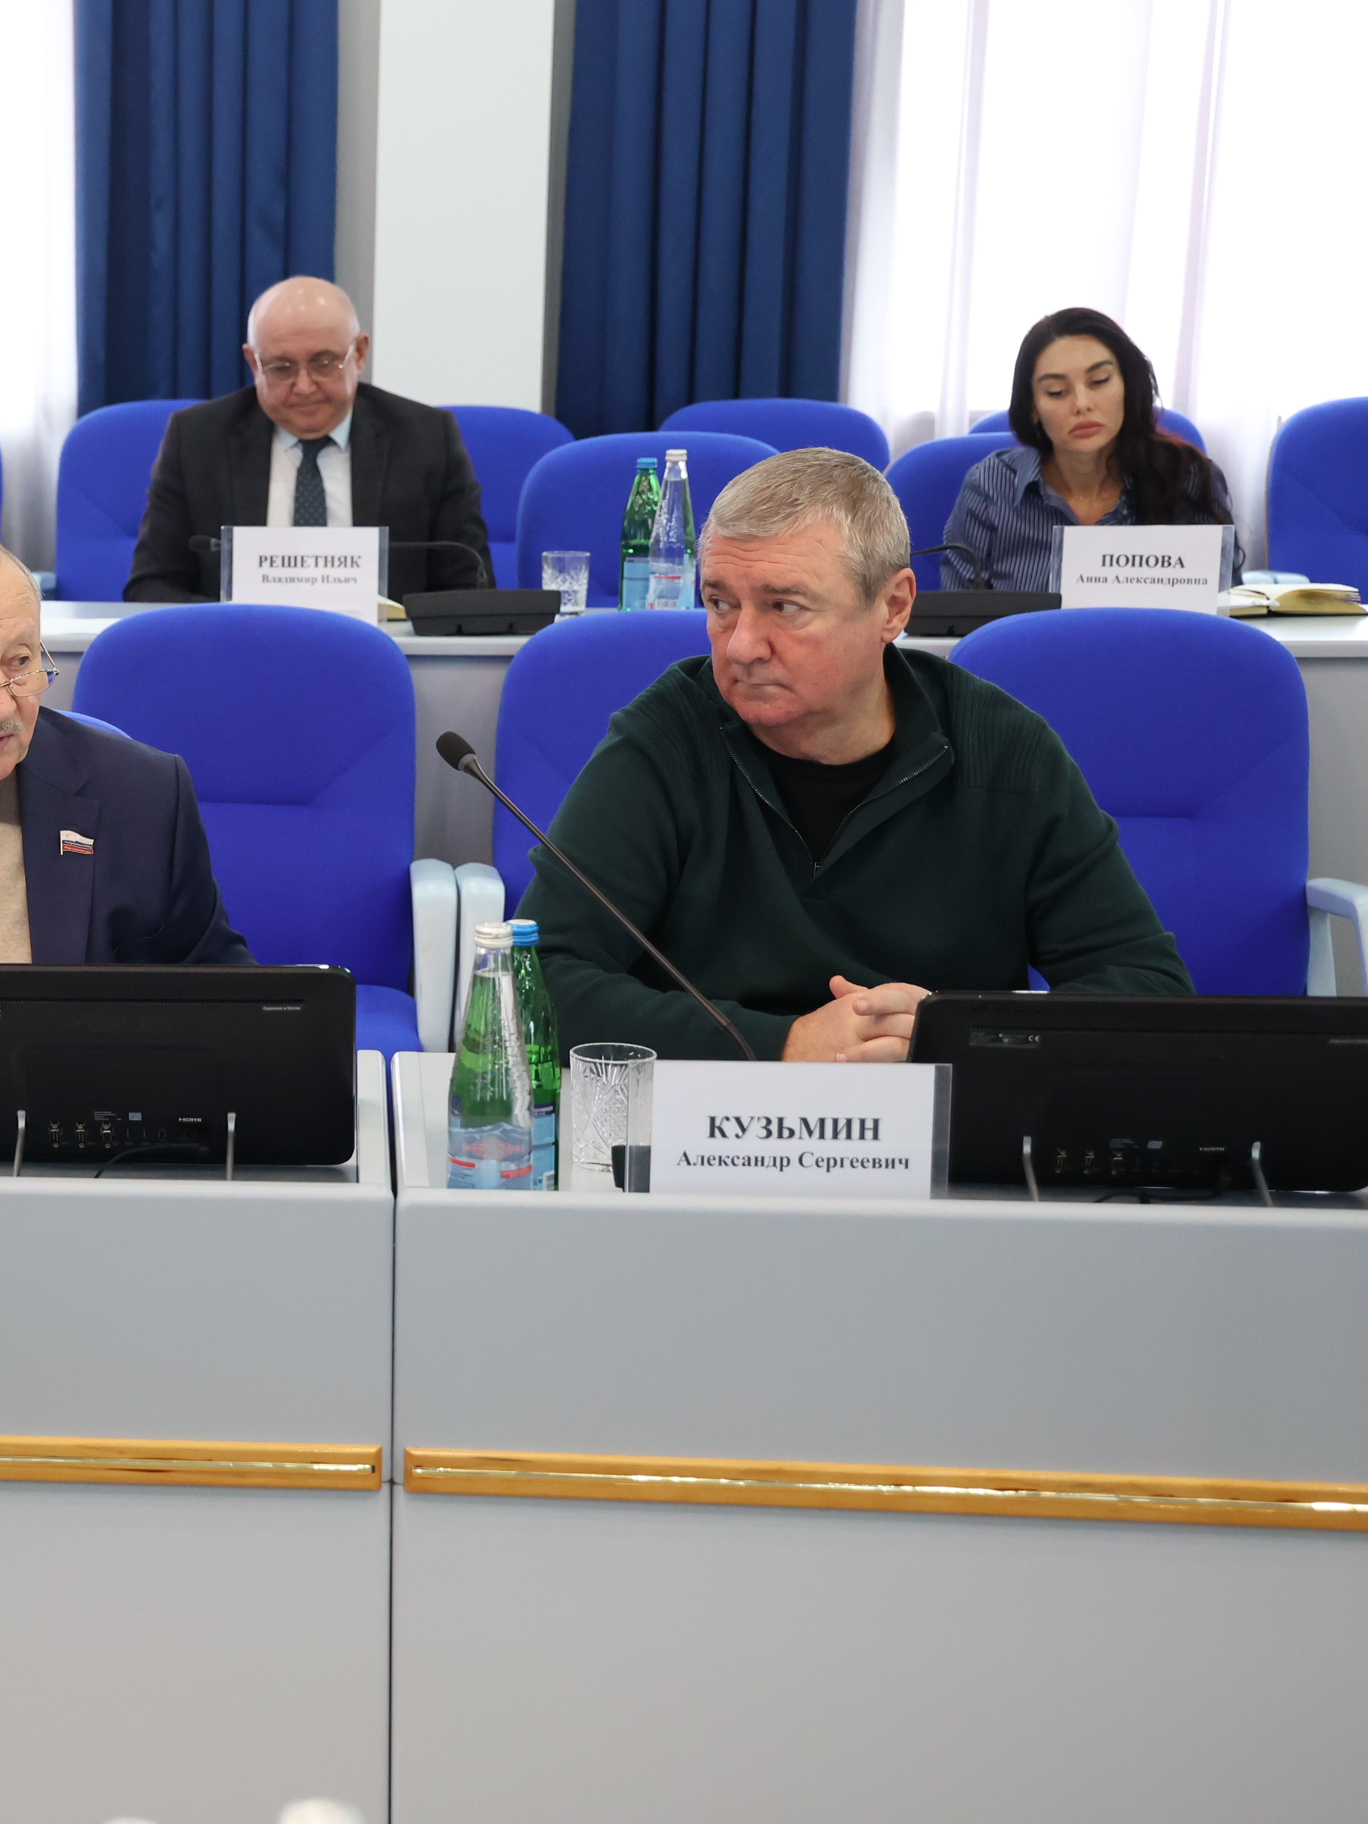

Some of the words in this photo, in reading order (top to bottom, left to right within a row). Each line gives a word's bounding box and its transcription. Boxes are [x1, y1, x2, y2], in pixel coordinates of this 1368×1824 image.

[258, 554, 362, 569] РЕШЕТНЯК
[1100, 553, 1185, 569] ПОПОВА
[261, 574, 318, 586] Владимир
[321, 574, 358, 584] Ильич
[1076, 573, 1108, 584] Анна
[1112, 574, 1208, 588] Александровна
[706, 1115, 882, 1141] КУЗЬМИН
[676, 1150, 791, 1173] Александр
[797, 1151, 910, 1173] Сергеевич
